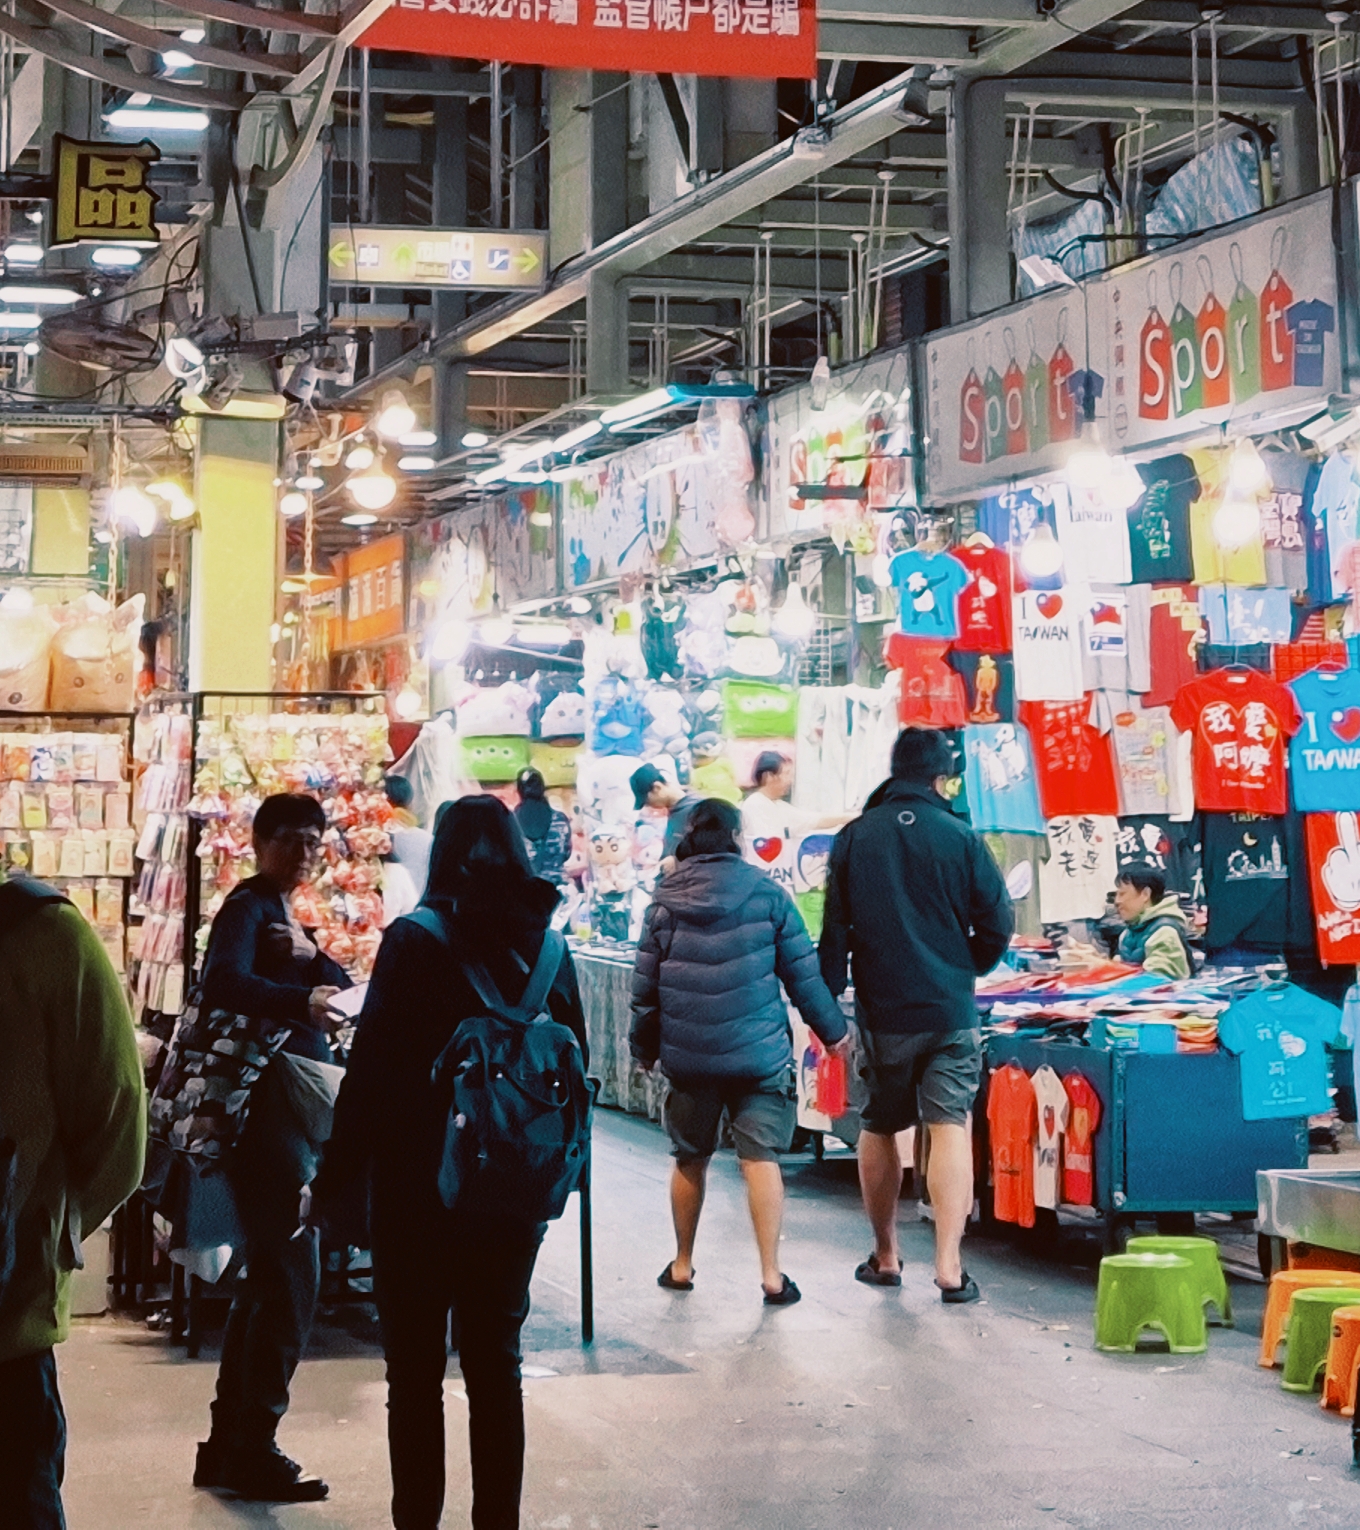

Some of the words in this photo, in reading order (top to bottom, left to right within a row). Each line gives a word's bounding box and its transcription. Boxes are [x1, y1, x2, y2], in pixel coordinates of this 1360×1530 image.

[1142, 300, 1284, 415] Sport
[962, 368, 1068, 463] Sport
[1020, 596, 1027, 620] I
[1017, 626, 1069, 642] TAIWAN
[1204, 701, 1268, 742] 我愛
[1305, 711, 1318, 743] I
